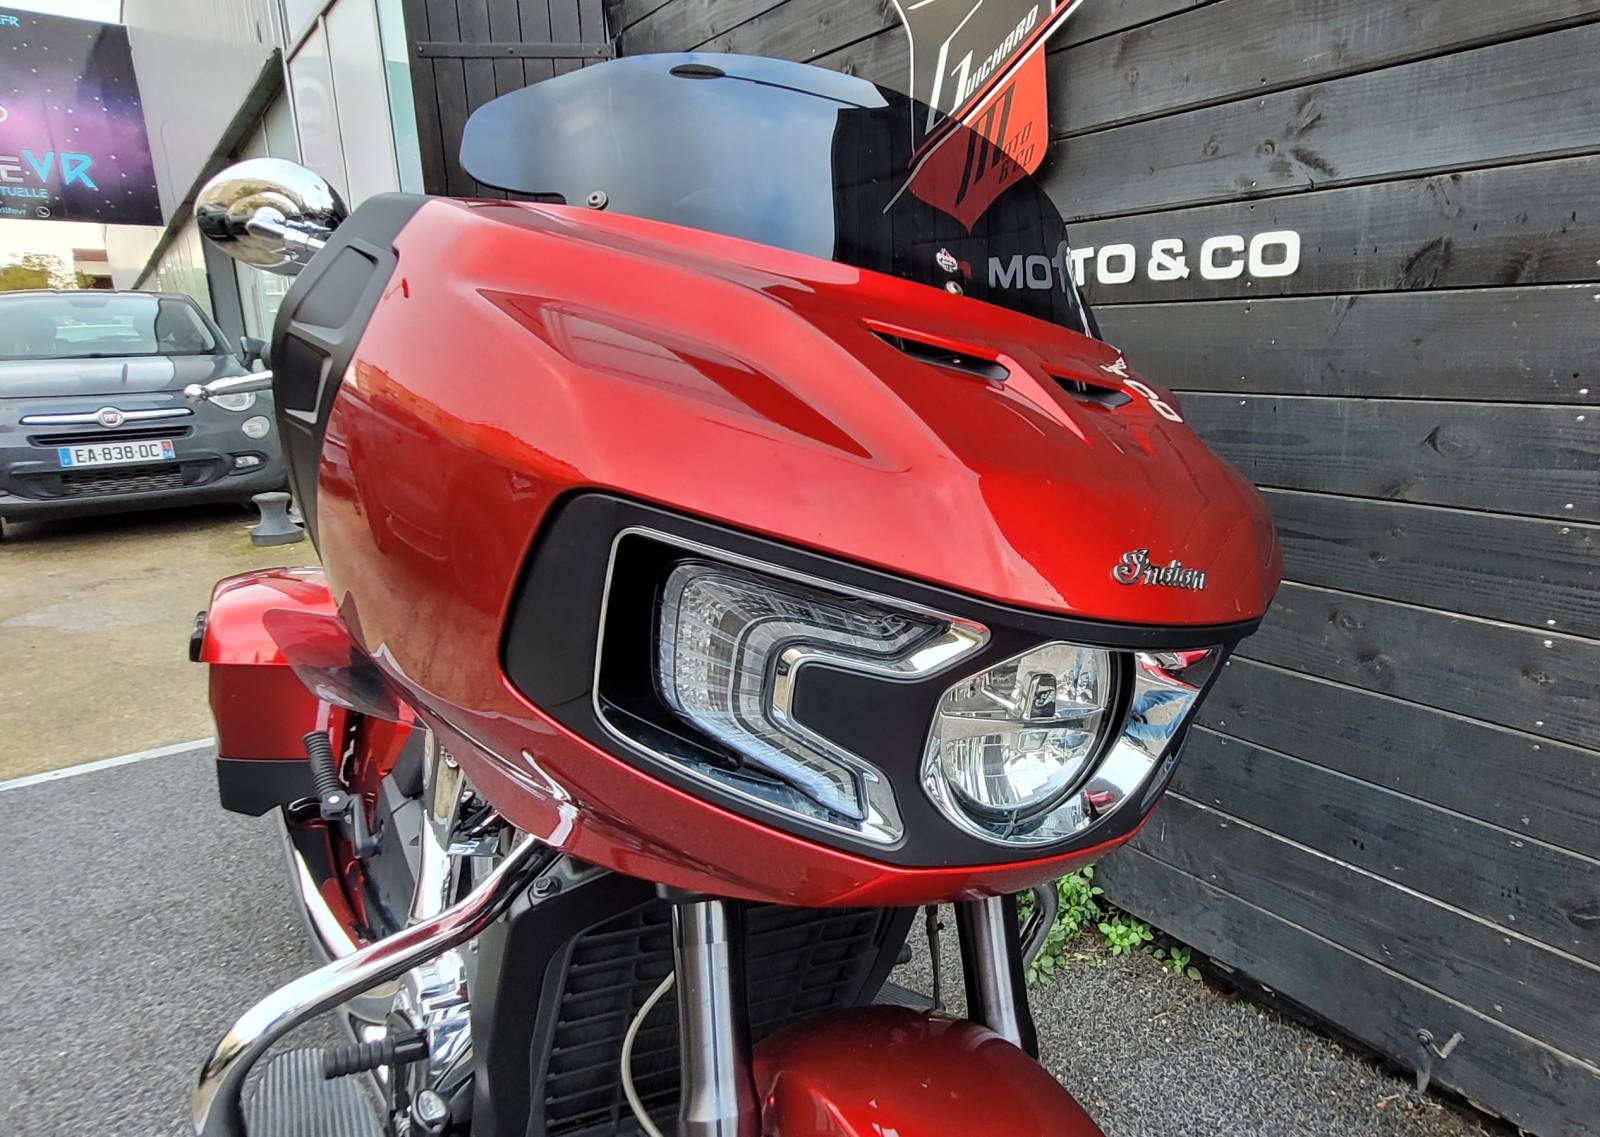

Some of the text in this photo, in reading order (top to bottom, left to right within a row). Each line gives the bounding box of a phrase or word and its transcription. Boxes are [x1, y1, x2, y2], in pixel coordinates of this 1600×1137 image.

[1147, 237, 1191, 282] &
[1199, 229, 1302, 280] CO
[74, 443, 160, 464] EA-838-DC
[1111, 548, 1206, 591] Indian
